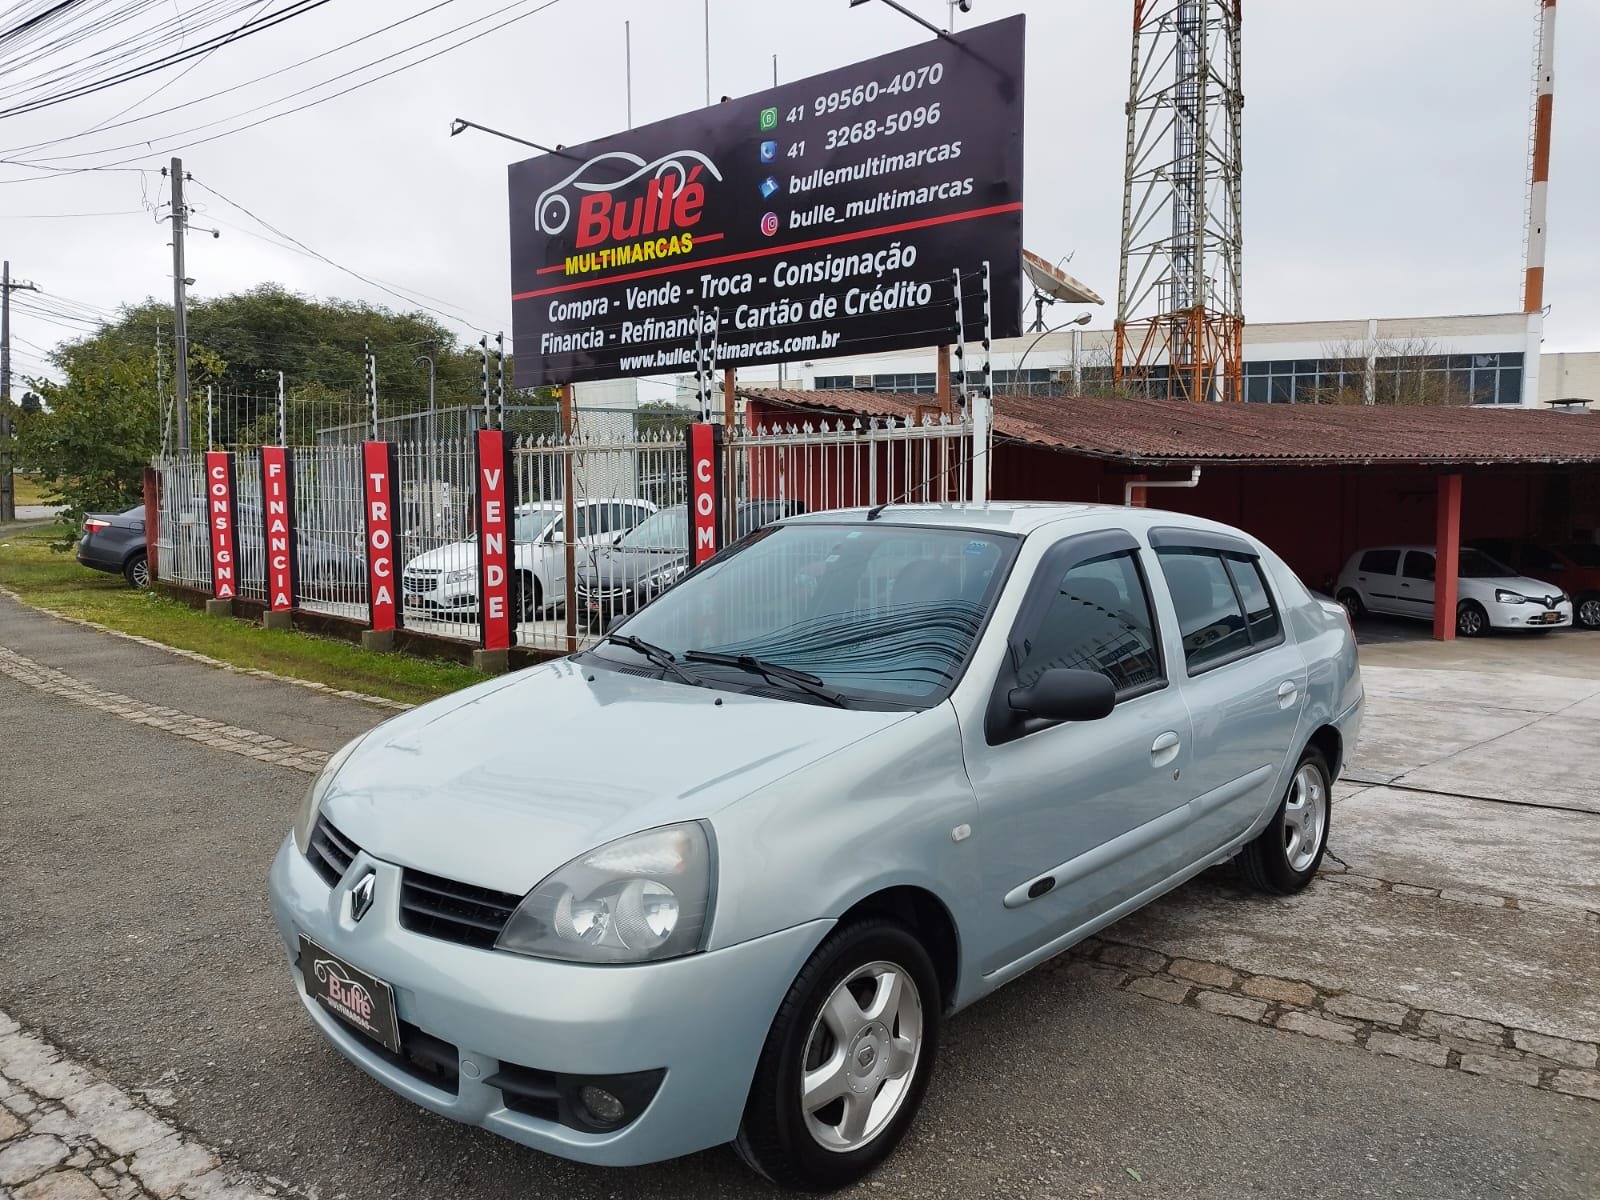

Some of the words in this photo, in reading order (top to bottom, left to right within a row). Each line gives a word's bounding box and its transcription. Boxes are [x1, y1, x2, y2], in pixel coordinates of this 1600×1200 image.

[786, 105, 805, 123] 41
[814, 63, 944, 117] 99560-4070
[787, 140, 806, 159] 41
[825, 103, 941, 150] 3268-5096
[788, 140, 962, 195] bullemultimarcas
[576, 166, 705, 248] Bullé
[789, 177, 974, 230] bulle_multimarcas
[548, 298, 609, 322] Compra
[626, 282, 681, 310] Vende
[700, 274, 753, 299] Troca
[773, 242, 917, 288] Consignação
[565, 232, 693, 275] MULTIMARCAS
[541, 327, 604, 355] Financia
[621, 310, 716, 344] Refinancia
[735, 298, 803, 330] Cartão
[809, 293, 838, 320] de
[844, 281, 932, 315] Crédito
[619, 331, 841, 371] www.bulleutimarcas.com.br
[211, 466, 233, 596] CONSIGNA
[269, 463, 289, 606] FINANCIA
[370, 473, 393, 606] TROCA
[483, 468, 504, 618] VENDE
[697, 458, 714, 565] COM
[329, 975, 371, 1019] Bullé
